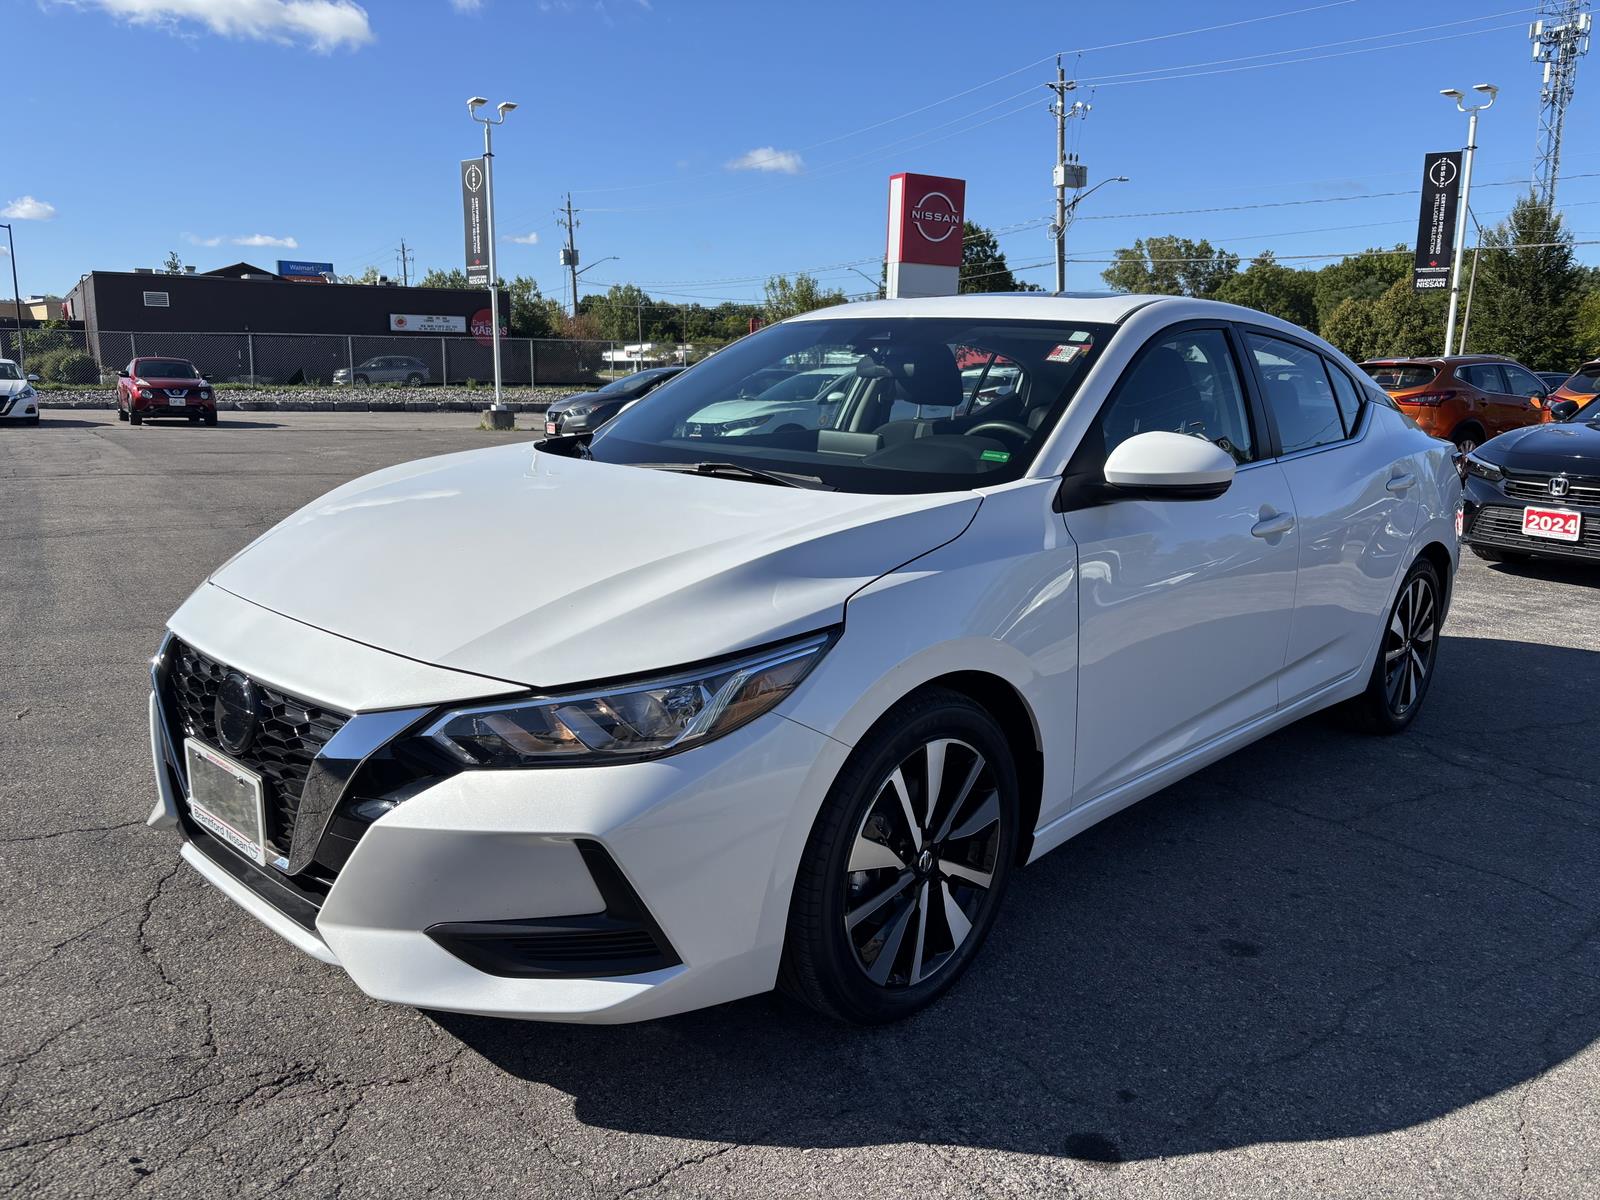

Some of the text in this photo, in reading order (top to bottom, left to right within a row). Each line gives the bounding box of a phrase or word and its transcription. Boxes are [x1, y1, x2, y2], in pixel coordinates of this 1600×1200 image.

[1438, 157, 1448, 188] NISSAN
[911, 210, 960, 223] NISSAN
[1429, 193, 1440, 255] INTELLIGENT SELECTION
[1435, 193, 1446, 255] CERTIFIED PRE-OWNED
[1528, 515, 1577, 533] 2024
[194, 807, 248, 853] Brantford Nissan
